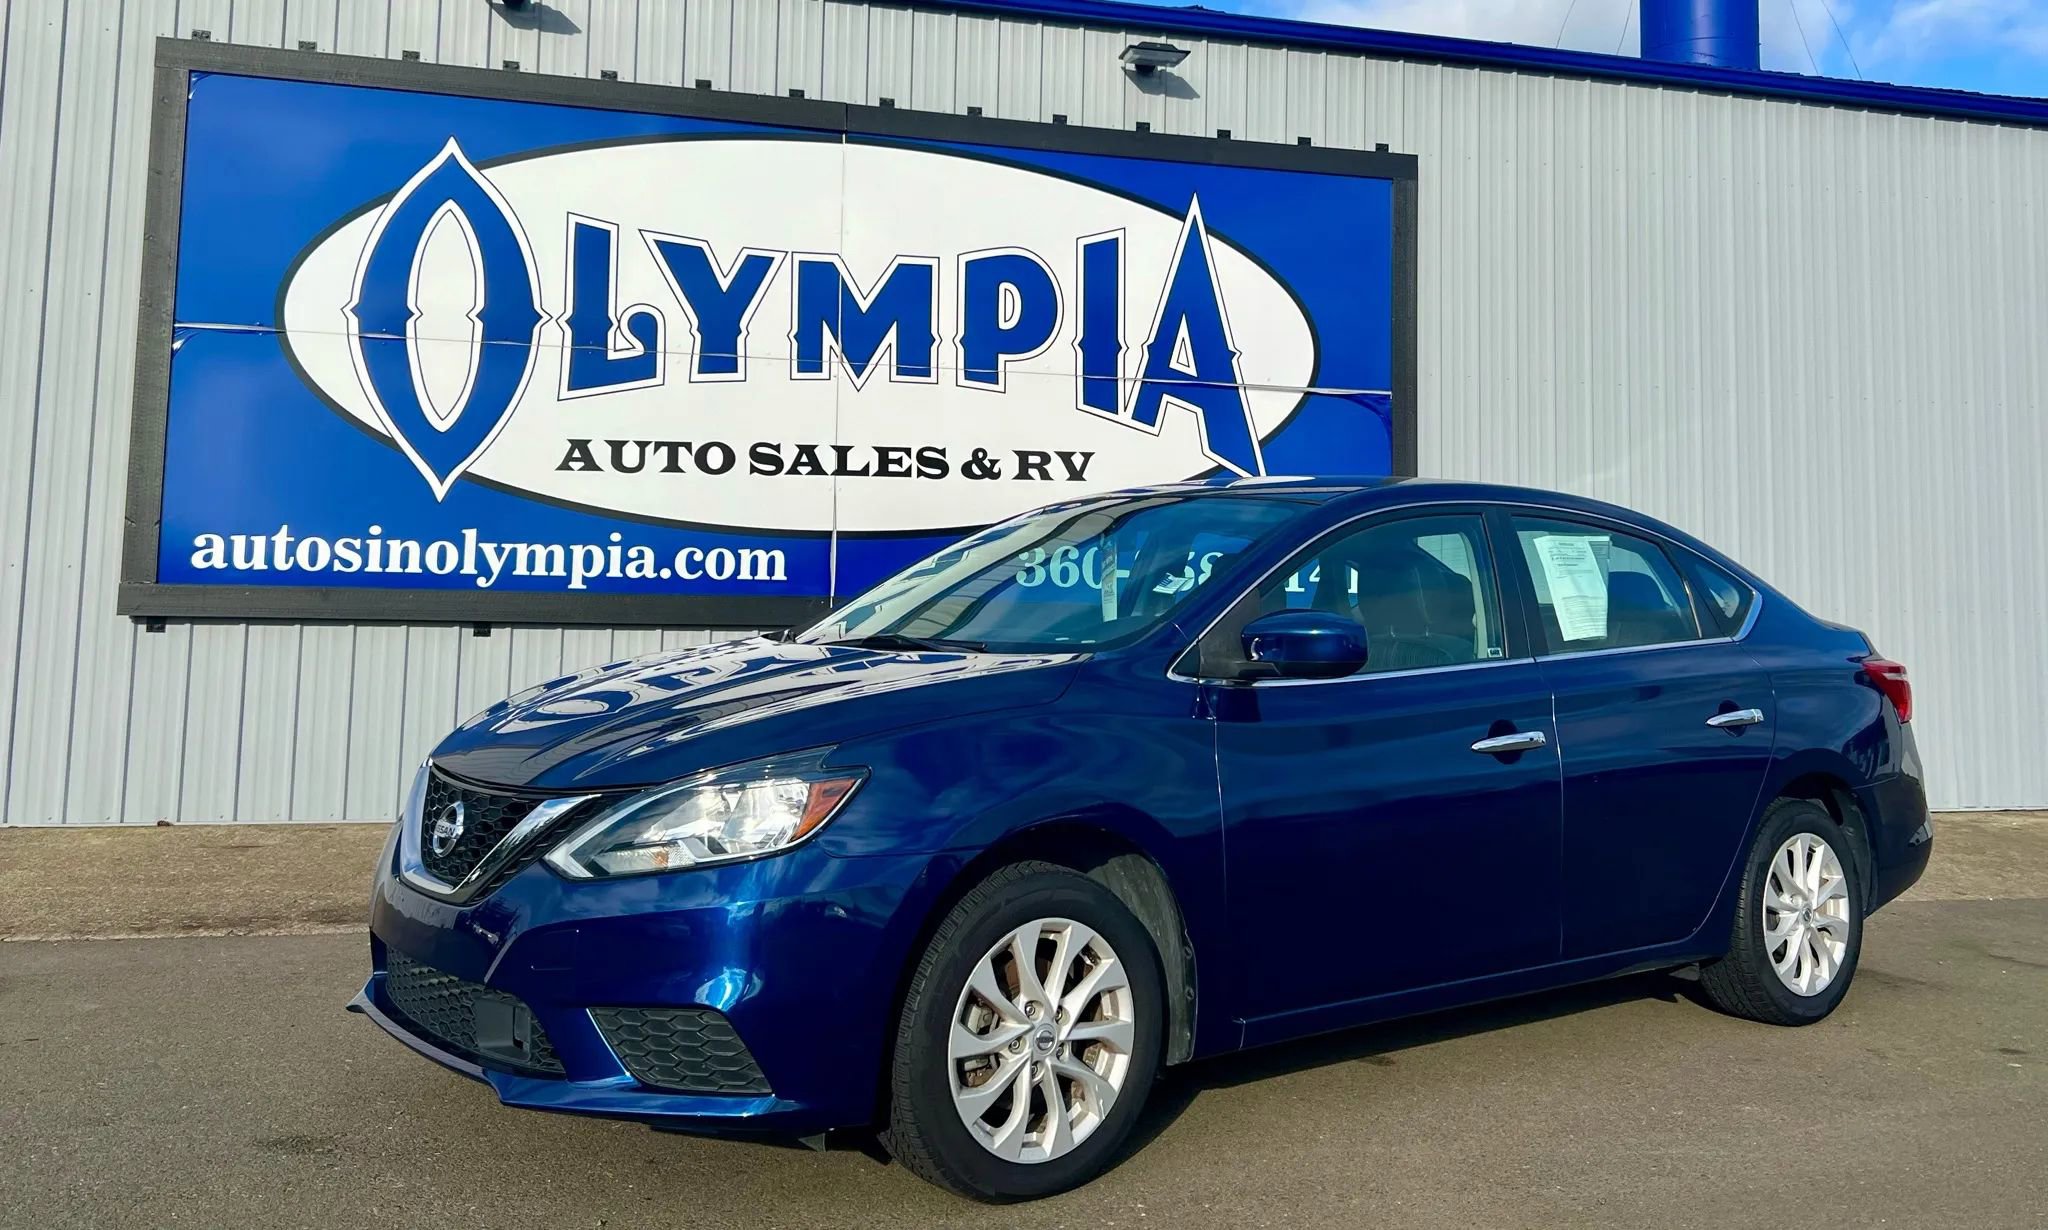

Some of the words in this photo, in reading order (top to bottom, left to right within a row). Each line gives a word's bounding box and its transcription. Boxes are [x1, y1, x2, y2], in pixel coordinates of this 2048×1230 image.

[341, 135, 1266, 502] OLYMPIA
[555, 438, 736, 476] AUTO
[748, 442, 950, 481] SALES
[961, 447, 1002, 481] &
[1011, 450, 1096, 482] RV
[190, 525, 788, 590] autosinolympia.com
